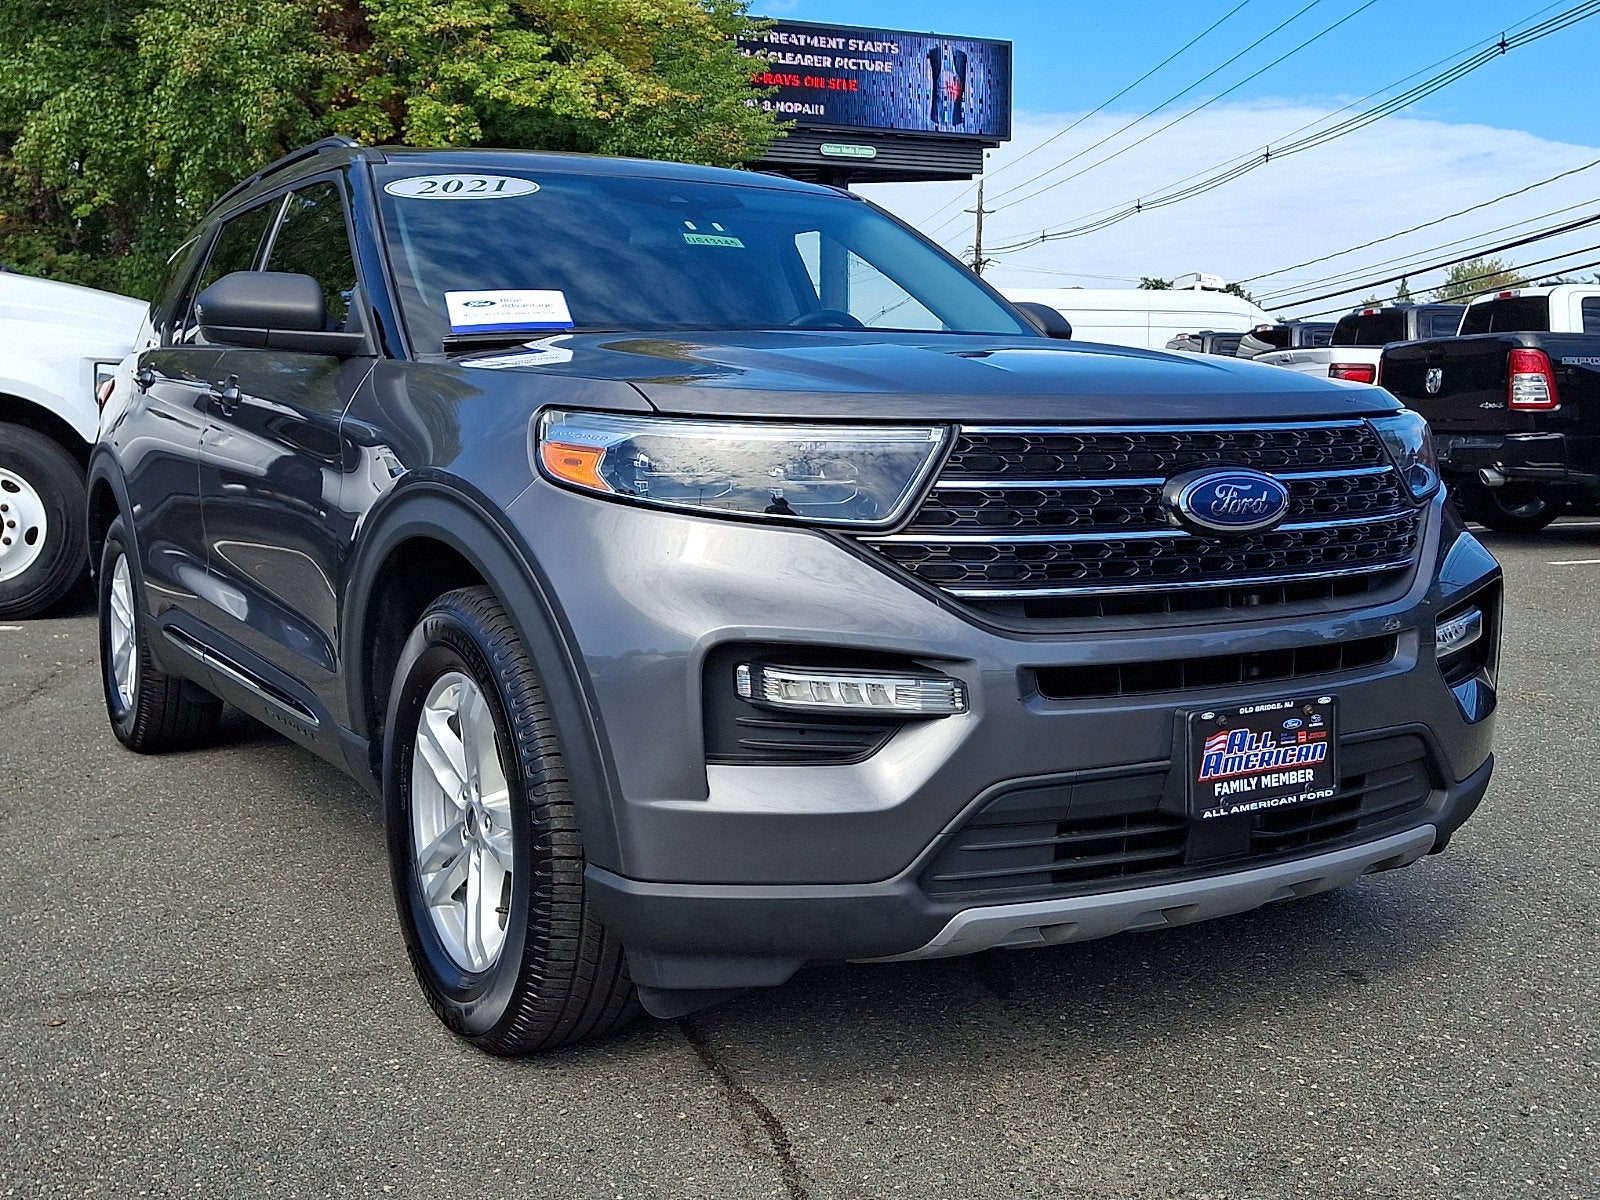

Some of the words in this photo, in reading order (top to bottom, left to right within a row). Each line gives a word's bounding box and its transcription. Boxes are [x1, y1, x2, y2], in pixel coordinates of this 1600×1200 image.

[848, 39, 899, 54] STARTS
[834, 57, 893, 73] PICTURE
[803, 75, 825, 88] ON
[827, 77, 858, 92] SITE
[823, 145, 841, 153] Outdoor
[855, 147, 874, 155] Systems
[416, 179, 507, 195] 2021
[1211, 483, 1268, 517] Ford
[1239, 706, 1254, 715] OLD
[1214, 776, 1259, 797] FAMILY
[1261, 768, 1314, 789] MEMBER
[1202, 808, 1229, 819] ALL
[1230, 796, 1297, 814] AMERICAN
[1299, 789, 1334, 802] FORD
